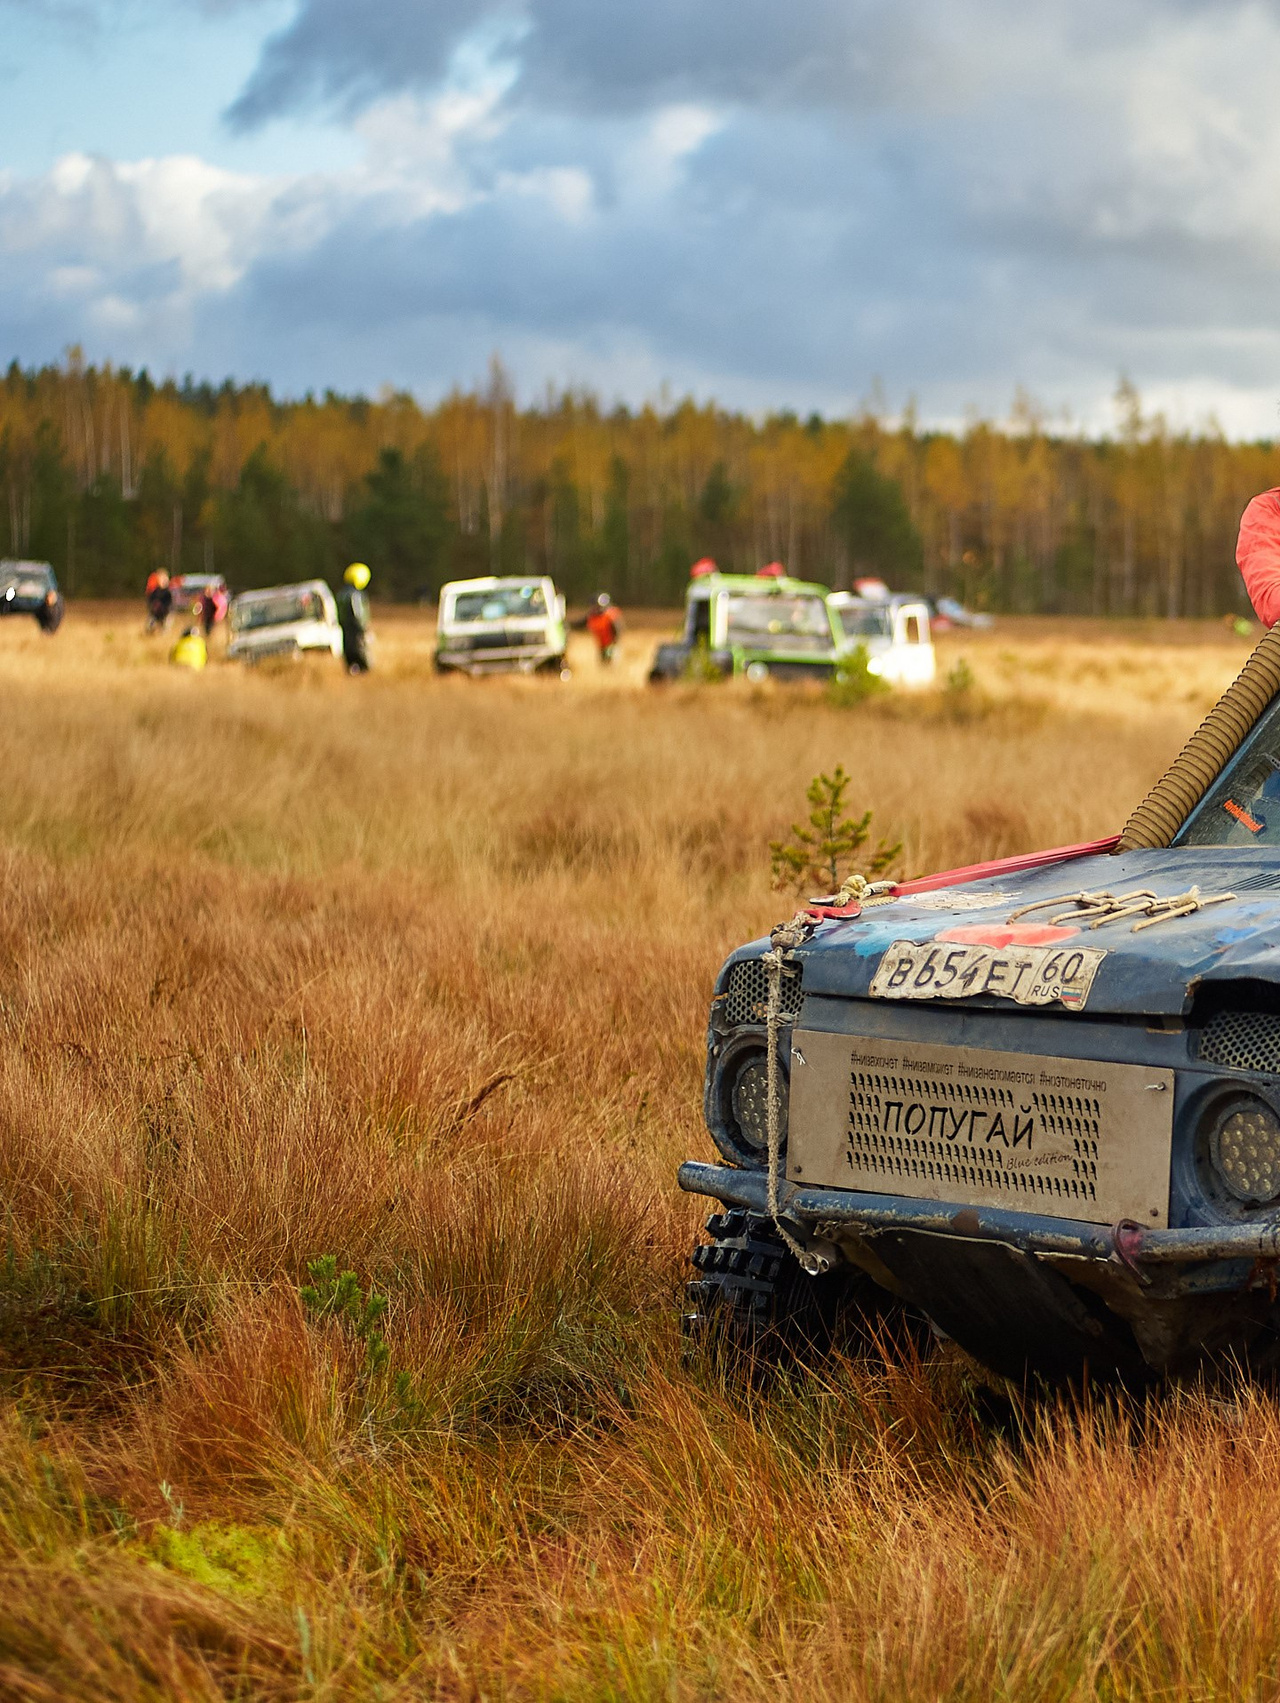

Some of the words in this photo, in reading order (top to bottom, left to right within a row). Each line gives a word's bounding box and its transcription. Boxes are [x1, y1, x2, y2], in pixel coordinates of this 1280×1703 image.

[1041, 952, 1085, 984] 60
[1031, 985, 1060, 999] RUS
[850, 1053, 899, 1071] #нивахочет
[902, 1056, 954, 1076] #ниваможет
[884, 1101, 1034, 1150] ПОПУГАЙ
[1006, 1156, 1032, 1170] Blue
[1034, 1151, 1074, 1166] edition
